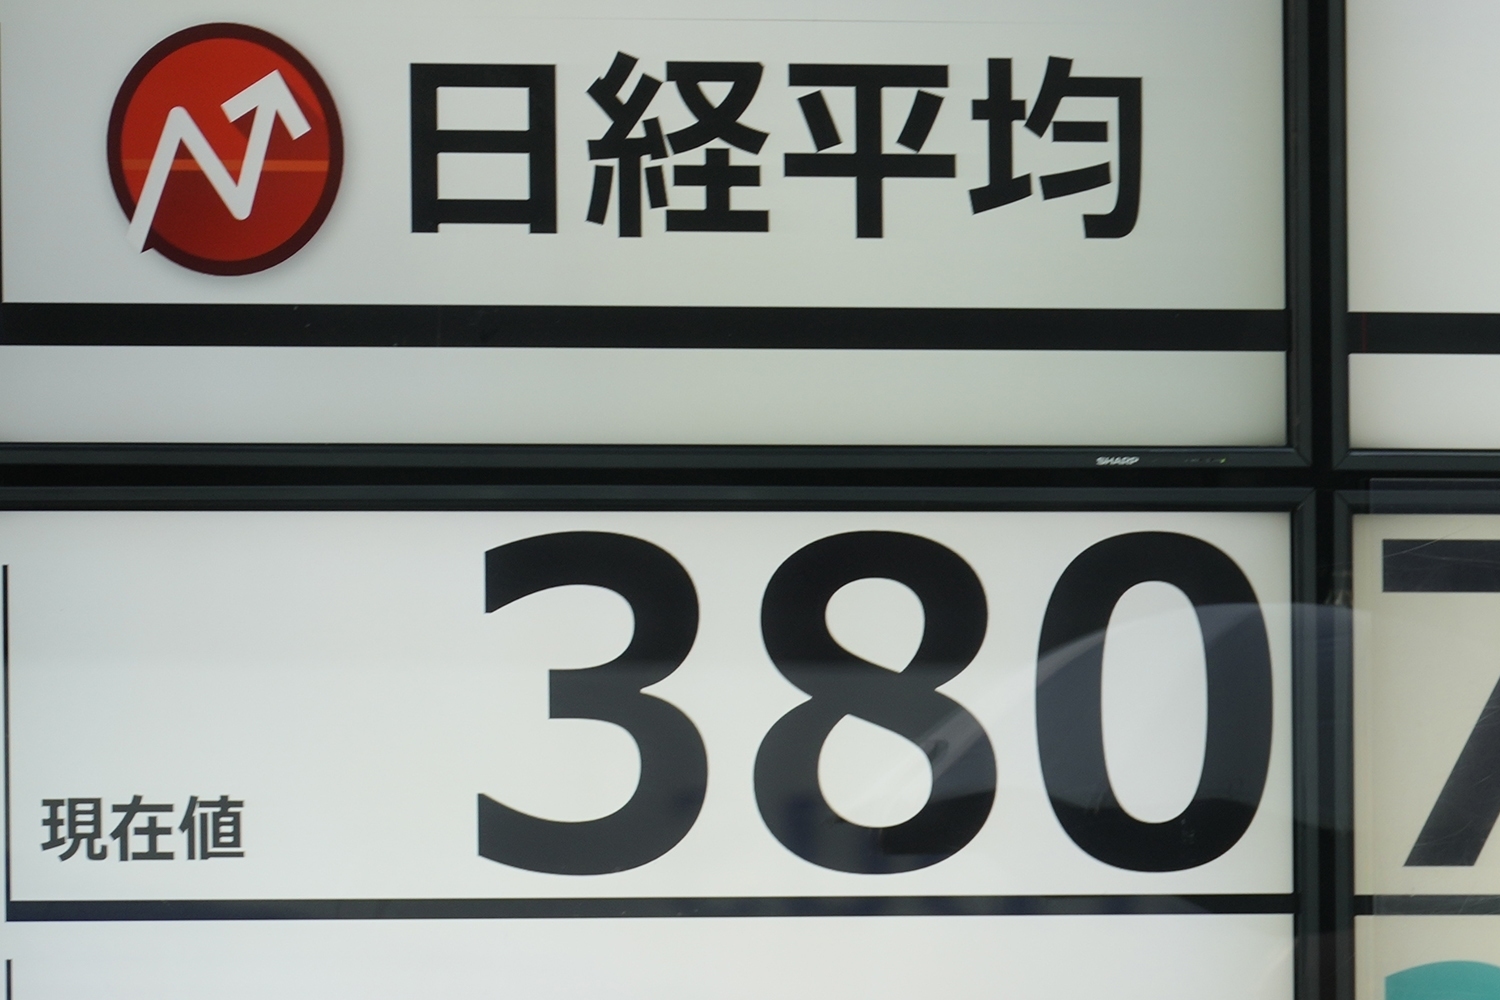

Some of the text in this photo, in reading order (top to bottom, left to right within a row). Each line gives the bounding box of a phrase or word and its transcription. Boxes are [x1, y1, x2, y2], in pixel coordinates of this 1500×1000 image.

[409, 51, 1144, 239] 日経平均
[1095, 456, 1140, 466] SHARP
[40, 794, 245, 862] 現在値
